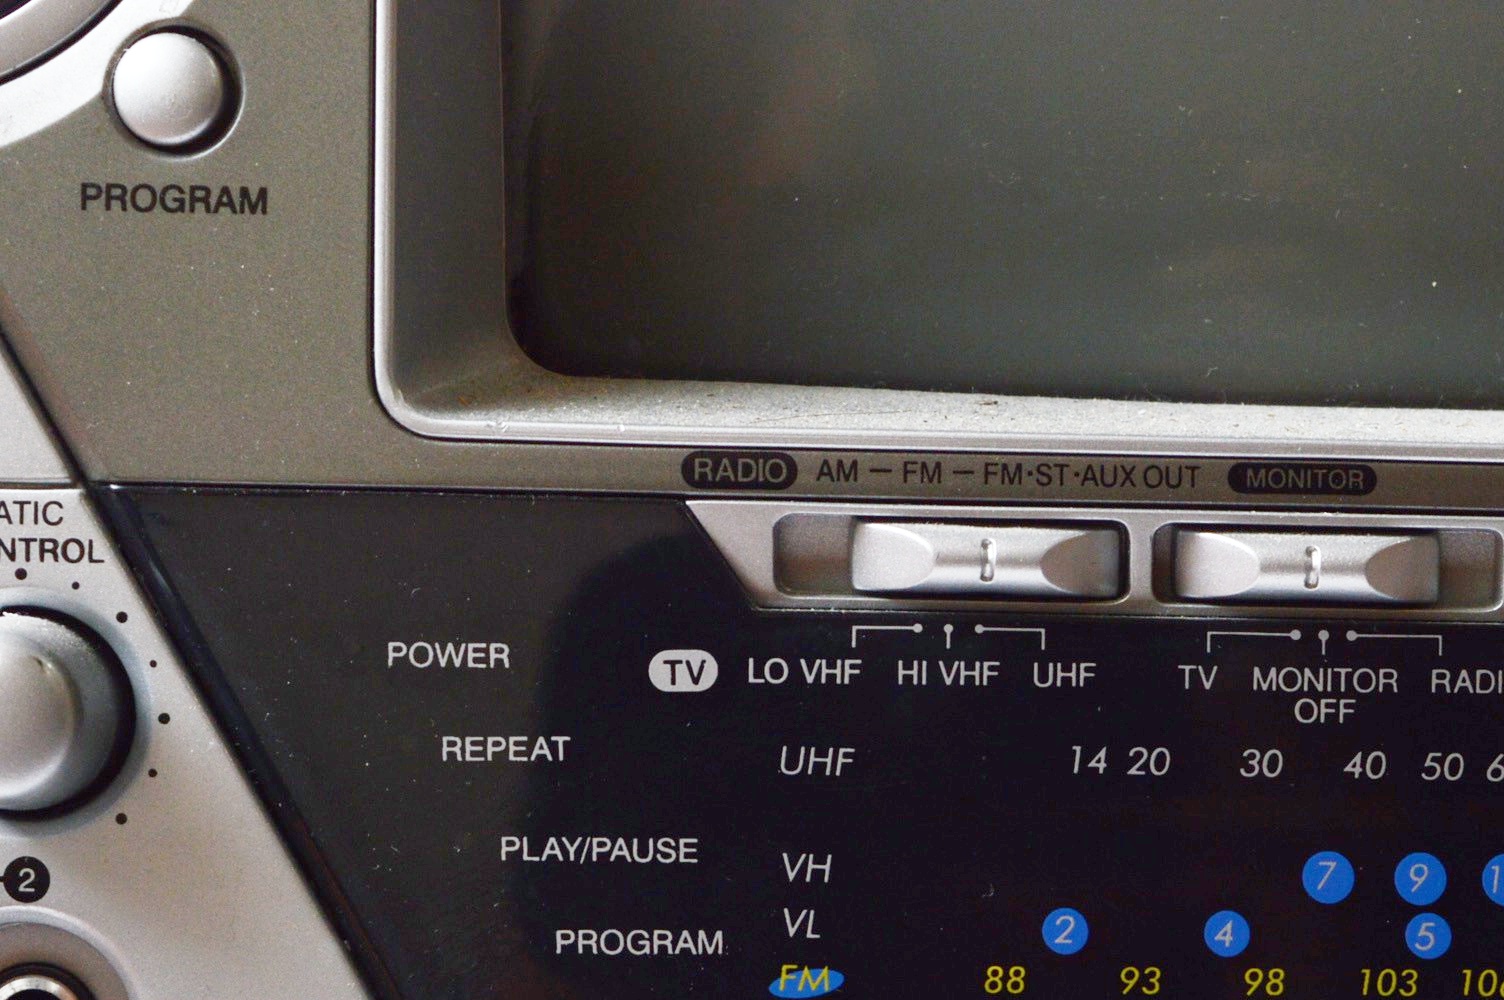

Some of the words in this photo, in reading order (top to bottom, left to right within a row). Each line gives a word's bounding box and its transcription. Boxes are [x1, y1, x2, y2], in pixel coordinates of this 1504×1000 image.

[81, 183, 267, 215] PROGRAM
[697, 458, 786, 482] RADIO
[816, 460, 857, 482] AM
[903, 461, 941, 484] FM
[1143, 465, 1200, 489] OUT
[1247, 468, 1363, 489] MONITOR
[388, 642, 509, 668] POWER
[663, 660, 706, 684] TV
[749, 658, 788, 684] LO
[800, 659, 862, 684] VHF
[898, 660, 927, 685] HI
[939, 661, 1000, 685] VHF
[1034, 663, 1096, 687] UHF
[1178, 665, 1217, 689] TV
[1253, 667, 1397, 693] MONITOR
[1295, 698, 1355, 723] OFF
[442, 736, 570, 761] REPEAT
[781, 746, 855, 776] UHF
[1073, 746, 1106, 773] 14
[1127, 747, 1170, 775] 20
[1240, 749, 1282, 777] 30
[1344, 751, 1386, 779] 40
[1422, 753, 1464, 780] 50
[501, 837, 698, 864] PLAY/PAUSE
[19, 868, 35, 892] 2
[783, 853, 831, 882] VH
[1318, 861, 1336, 889] 7
[1410, 864, 1428, 892] 9
[784, 908, 820, 938] VL
[1055, 916, 1074, 943] 2
[1215, 921, 1233, 947] 4
[556, 929, 722, 955] PROGRAM
[1415, 922, 1435, 951] 5
[780, 965, 829, 991] FM
[985, 966, 1025, 993] 88
[1121, 967, 1160, 994] 93
[1245, 968, 1284, 995] 98
[1362, 969, 1417, 996] 103
